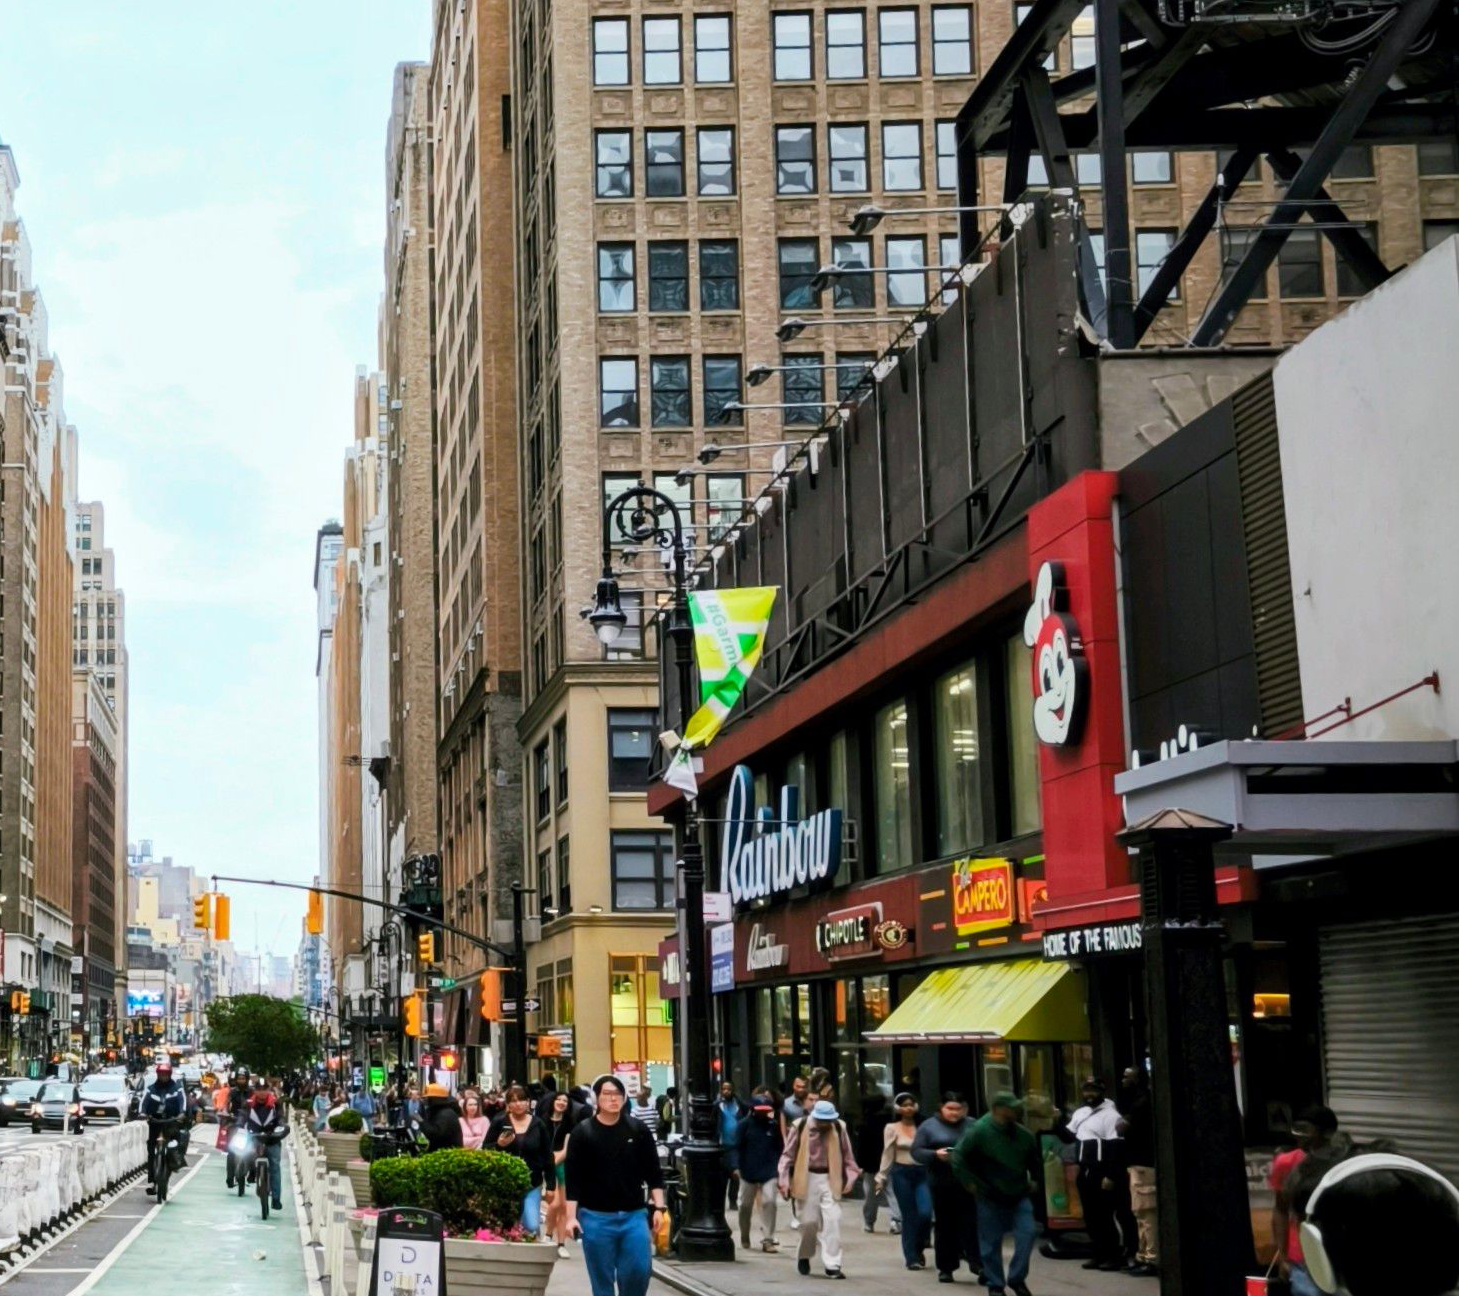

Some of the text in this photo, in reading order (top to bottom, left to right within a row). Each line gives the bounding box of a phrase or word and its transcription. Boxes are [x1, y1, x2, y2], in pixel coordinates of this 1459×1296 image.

[720, 764, 833, 904] Rainbow
[954, 878, 1008, 915] CAMPERO
[824, 915, 865, 948] CHIPOTLE
[1043, 923, 1141, 957] HOME OF THE FAMOUS
[383, 1271, 433, 1285] DTA
